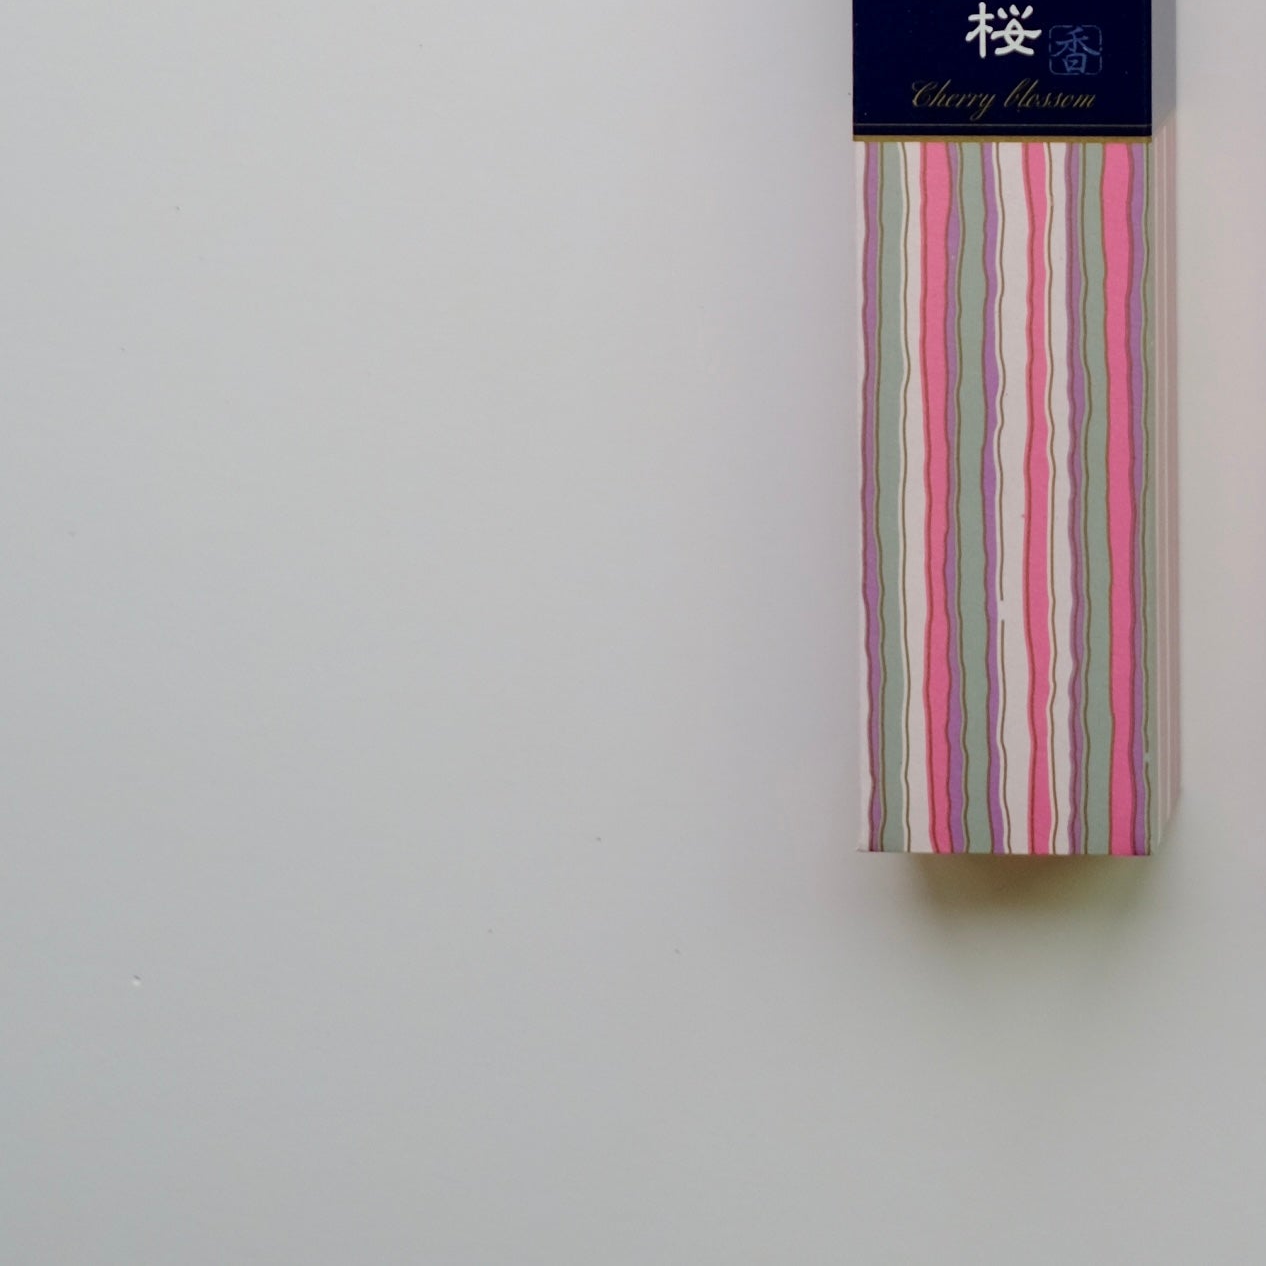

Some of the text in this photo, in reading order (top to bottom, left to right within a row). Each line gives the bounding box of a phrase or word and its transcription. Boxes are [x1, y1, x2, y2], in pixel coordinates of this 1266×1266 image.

[965, 2, 1042, 58] 桜
[1051, 26, 1100, 73] 香
[911, 77, 1096, 121] Cherry blossom
